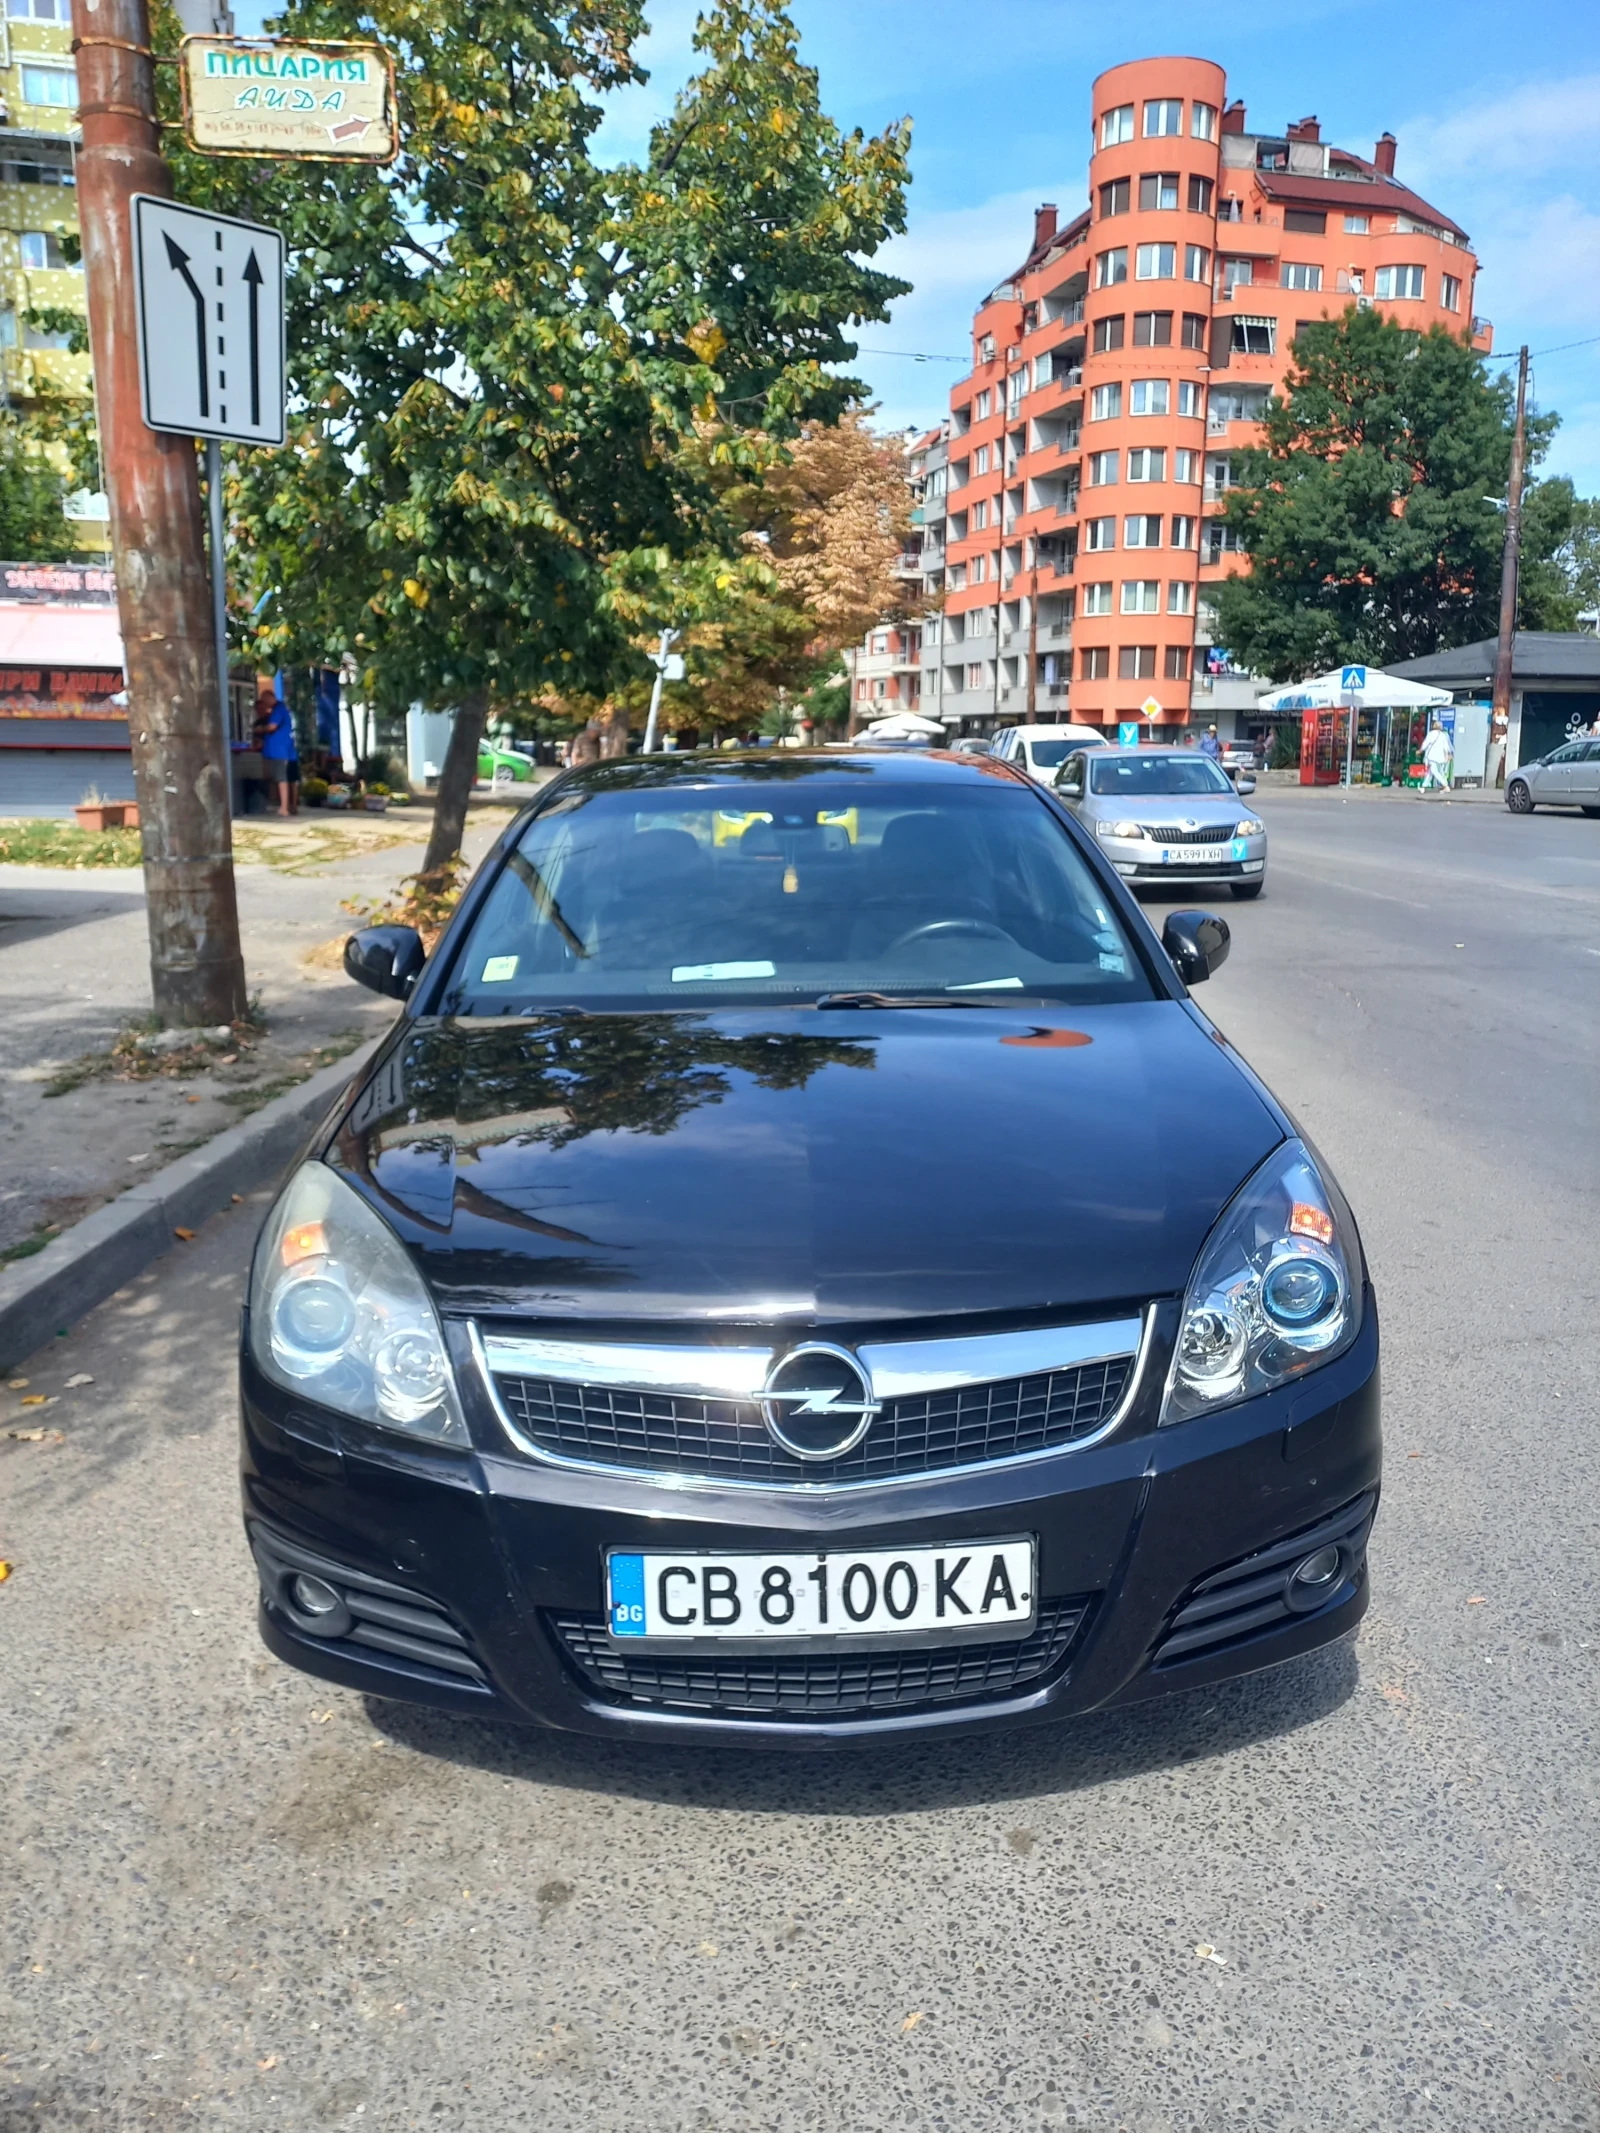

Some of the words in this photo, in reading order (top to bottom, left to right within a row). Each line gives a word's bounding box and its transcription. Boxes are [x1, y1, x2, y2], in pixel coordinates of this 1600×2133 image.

[205, 52, 368, 82] ПИЦАРИЯ
[236, 86, 346, 112] АИДА
[616, 1604, 643, 1623] BG
